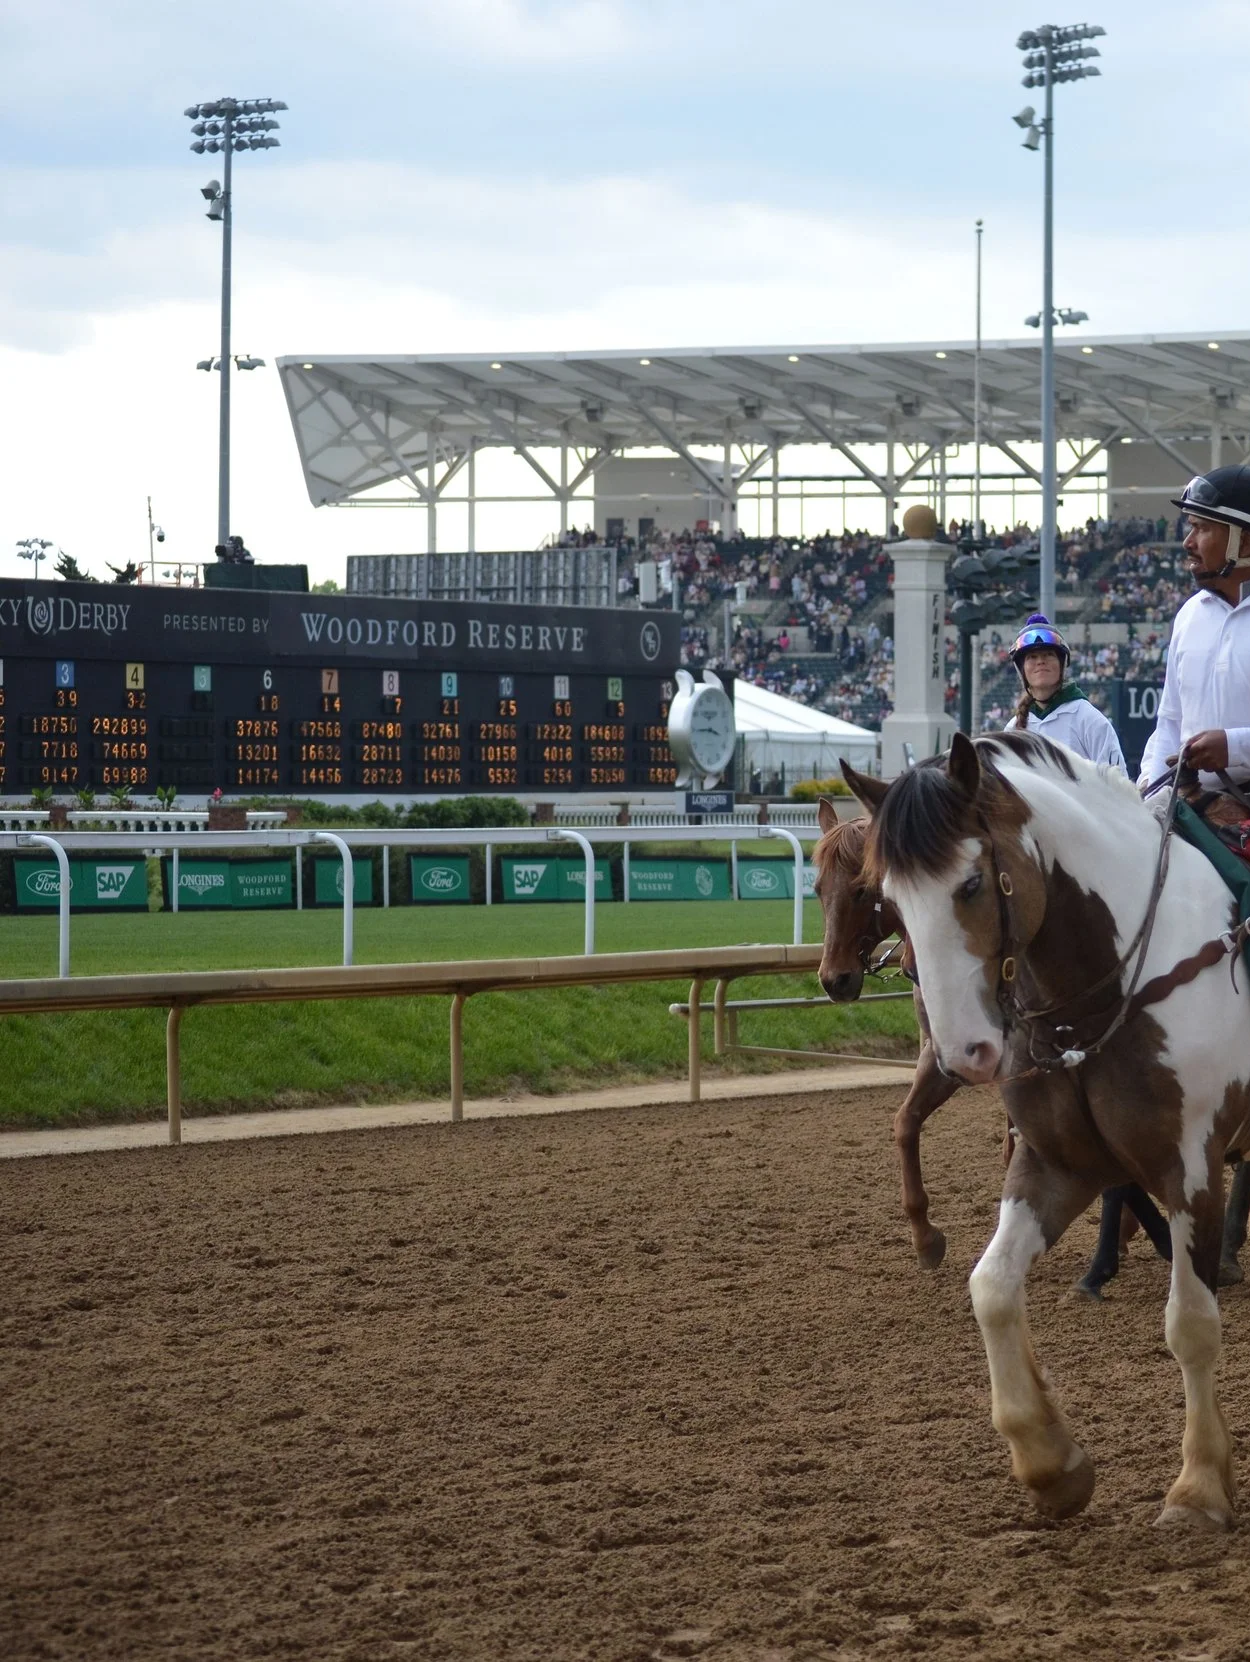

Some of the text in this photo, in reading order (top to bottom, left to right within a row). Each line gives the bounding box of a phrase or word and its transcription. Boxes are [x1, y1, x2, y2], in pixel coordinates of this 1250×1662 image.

[58, 597, 131, 636] DERBY
[163, 614, 270, 633] PRESENTED BY
[300, 612, 585, 652] WOODFORD RESERVE
[931, 594, 940, 679] FINISH
[61, 663, 70, 684] 3
[130, 666, 140, 686] 4
[263, 669, 273, 690] 6
[326, 671, 334, 691] 7
[387, 673, 395, 693] 8
[446, 675, 454, 694] 9
[500, 677, 513, 696] 10
[557, 677, 568, 697] 11
[610, 679, 621, 698] 12
[661, 681, 673, 700] 13
[57, 690, 78, 708] 39
[127, 691, 147, 709] 3-2
[260, 695, 280, 712] 18
[323, 696, 341, 712] 14
[394, 698, 402, 715] 7
[443, 699, 460, 715] 21
[500, 700, 517, 716] 25
[555, 701, 572, 717] 60
[617, 702, 625, 718] 3
[32, 717, 78, 734] 18750
[93, 718, 147, 735] 292899
[423, 723, 460, 740] 32761
[42, 742, 78, 759] 7718
[103, 742, 147, 760] 74669
[238, 744, 278, 761] 13201
[362, 745, 401, 761] 28711
[42, 766, 78, 783] 9147
[362, 768, 402, 785] 28723
[98, 872, 126, 892] SAP
[178, 874, 225, 887] ONGINES
[237, 875, 287, 885] WOODFORD
[428, 870, 453, 888] Ford
[515, 869, 539, 888] SAP
[631, 872, 674, 881] WOODFORD
[751, 872, 773, 888] Ford
[243, 887, 283, 896] RESERVE
[637, 883, 672, 892] RESERVE
